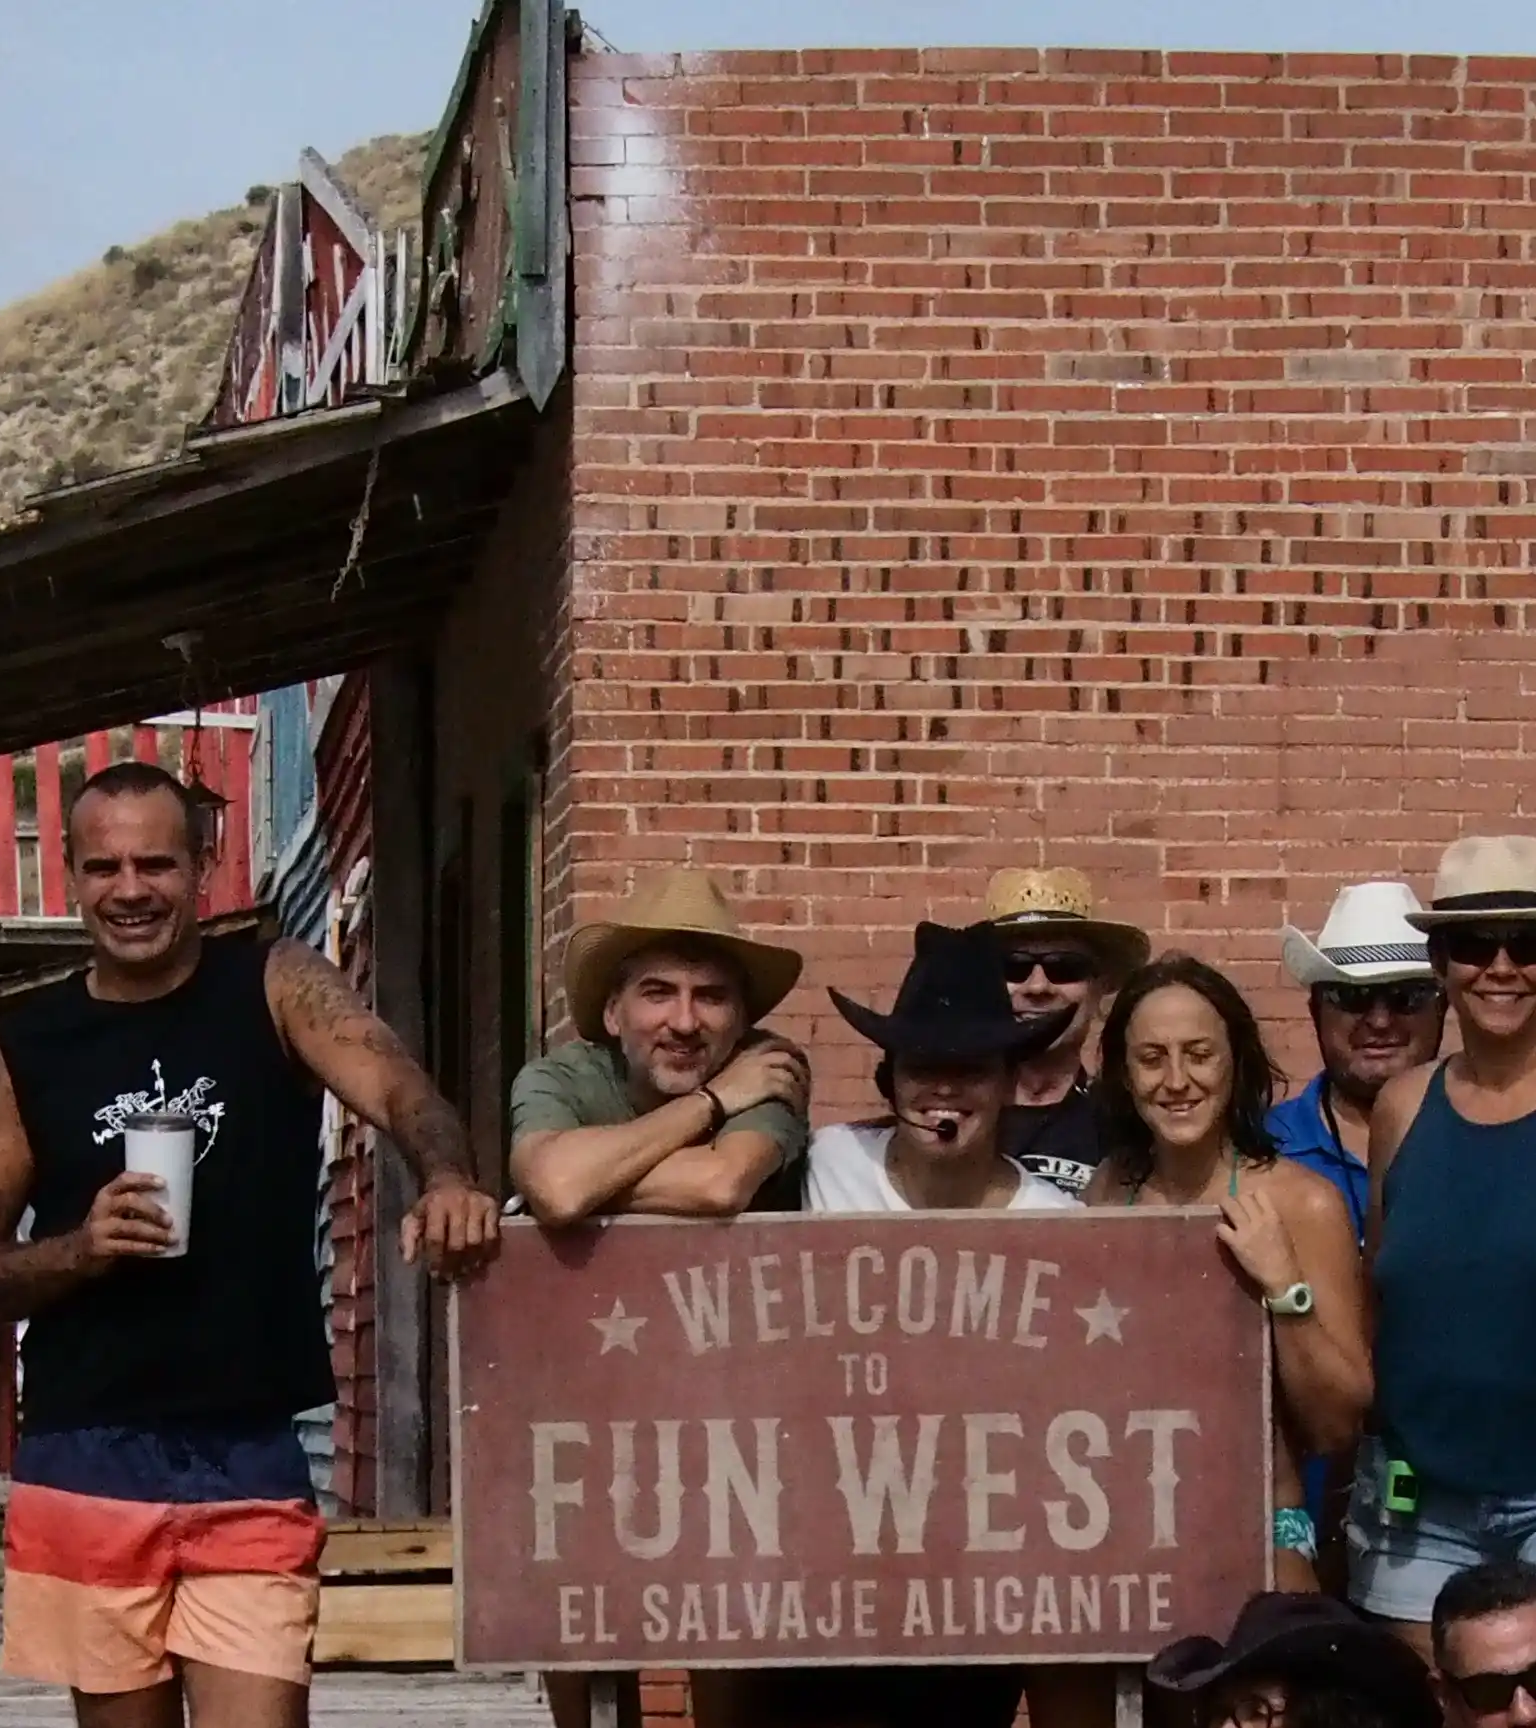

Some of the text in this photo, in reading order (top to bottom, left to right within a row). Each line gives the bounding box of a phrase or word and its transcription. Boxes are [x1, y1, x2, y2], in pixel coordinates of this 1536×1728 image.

[1038, 1157, 1093, 1181] JEA
[661, 1245, 1062, 1356] WELCOME
[837, 1352, 889, 1397] TO
[528, 1409, 1201, 1562] FUN WEST
[559, 1573, 1175, 1645] EL SALVAJE ALICANTE
